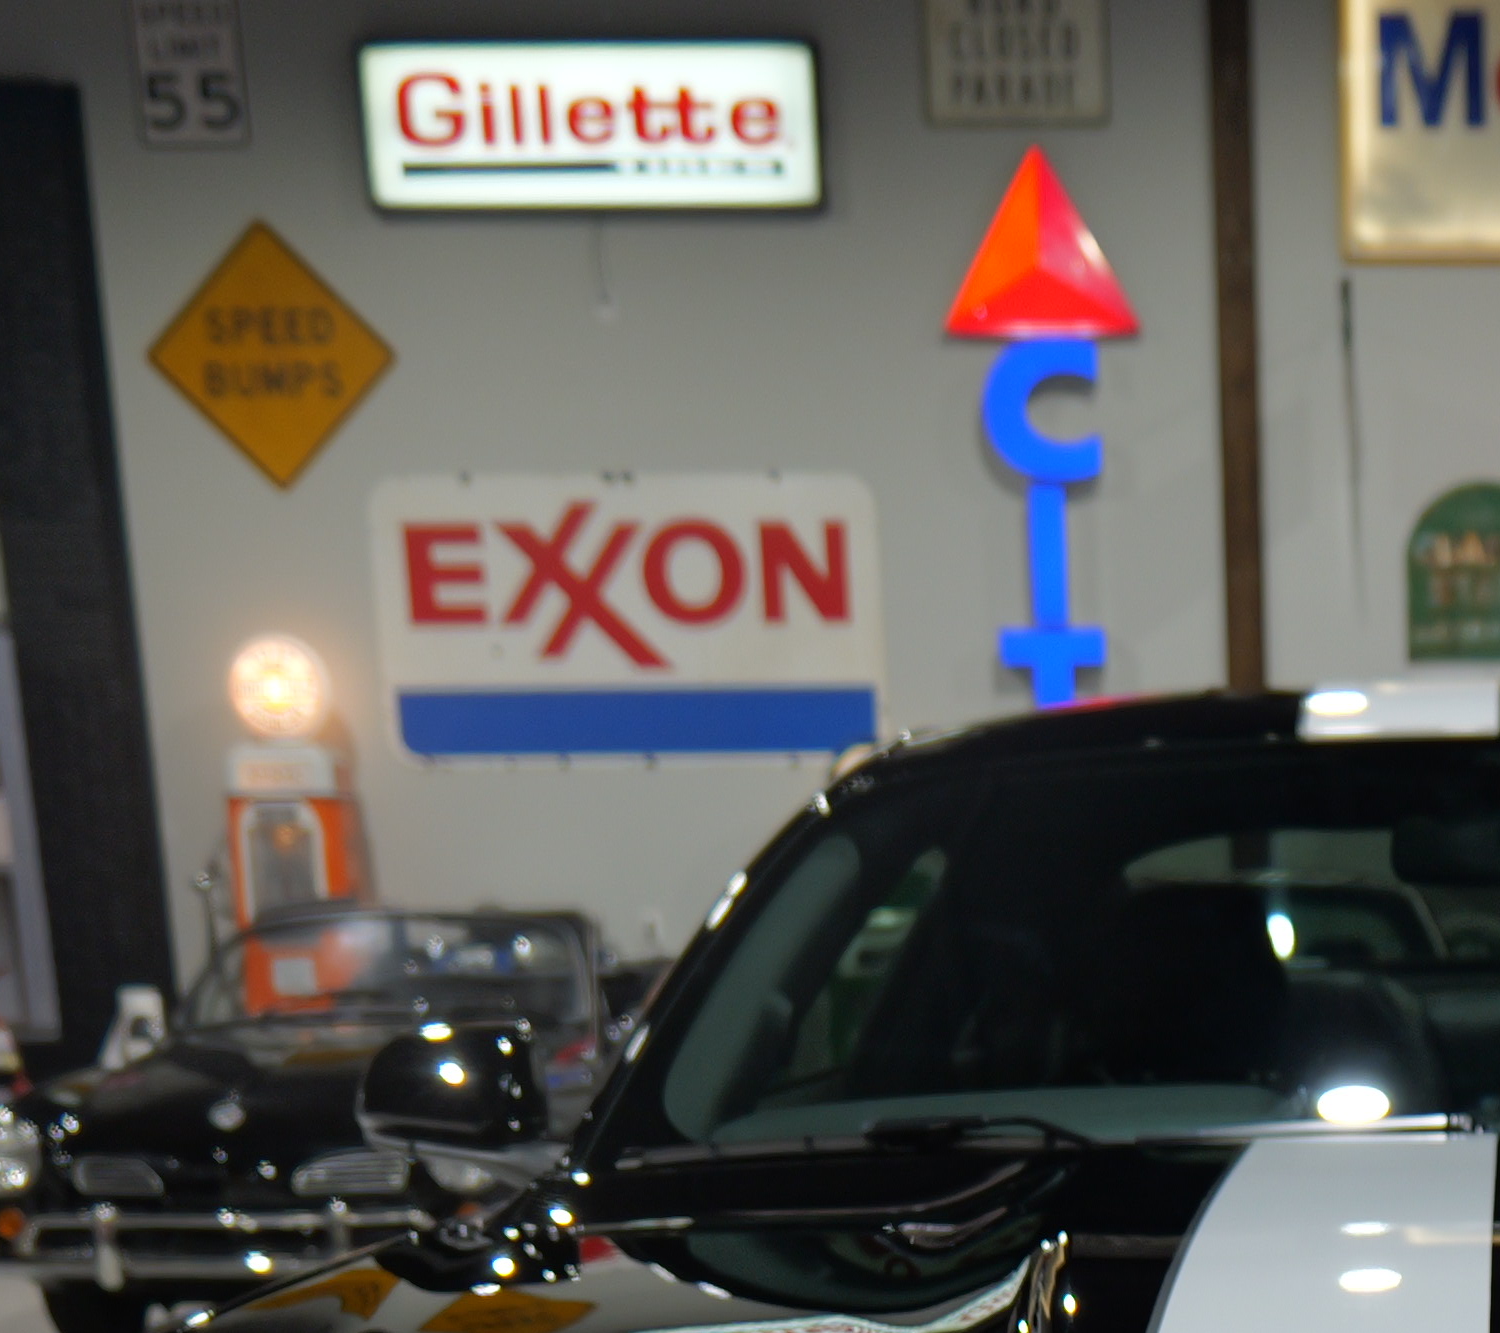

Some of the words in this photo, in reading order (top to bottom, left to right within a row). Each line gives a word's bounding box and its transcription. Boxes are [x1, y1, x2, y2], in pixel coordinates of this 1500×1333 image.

[146, 71, 241, 131] 55
[397, 72, 781, 148] Gillette
[205, 306, 338, 345] SPEED
[203, 360, 345, 399] BUMPS
[401, 500, 852, 670] EXXON
